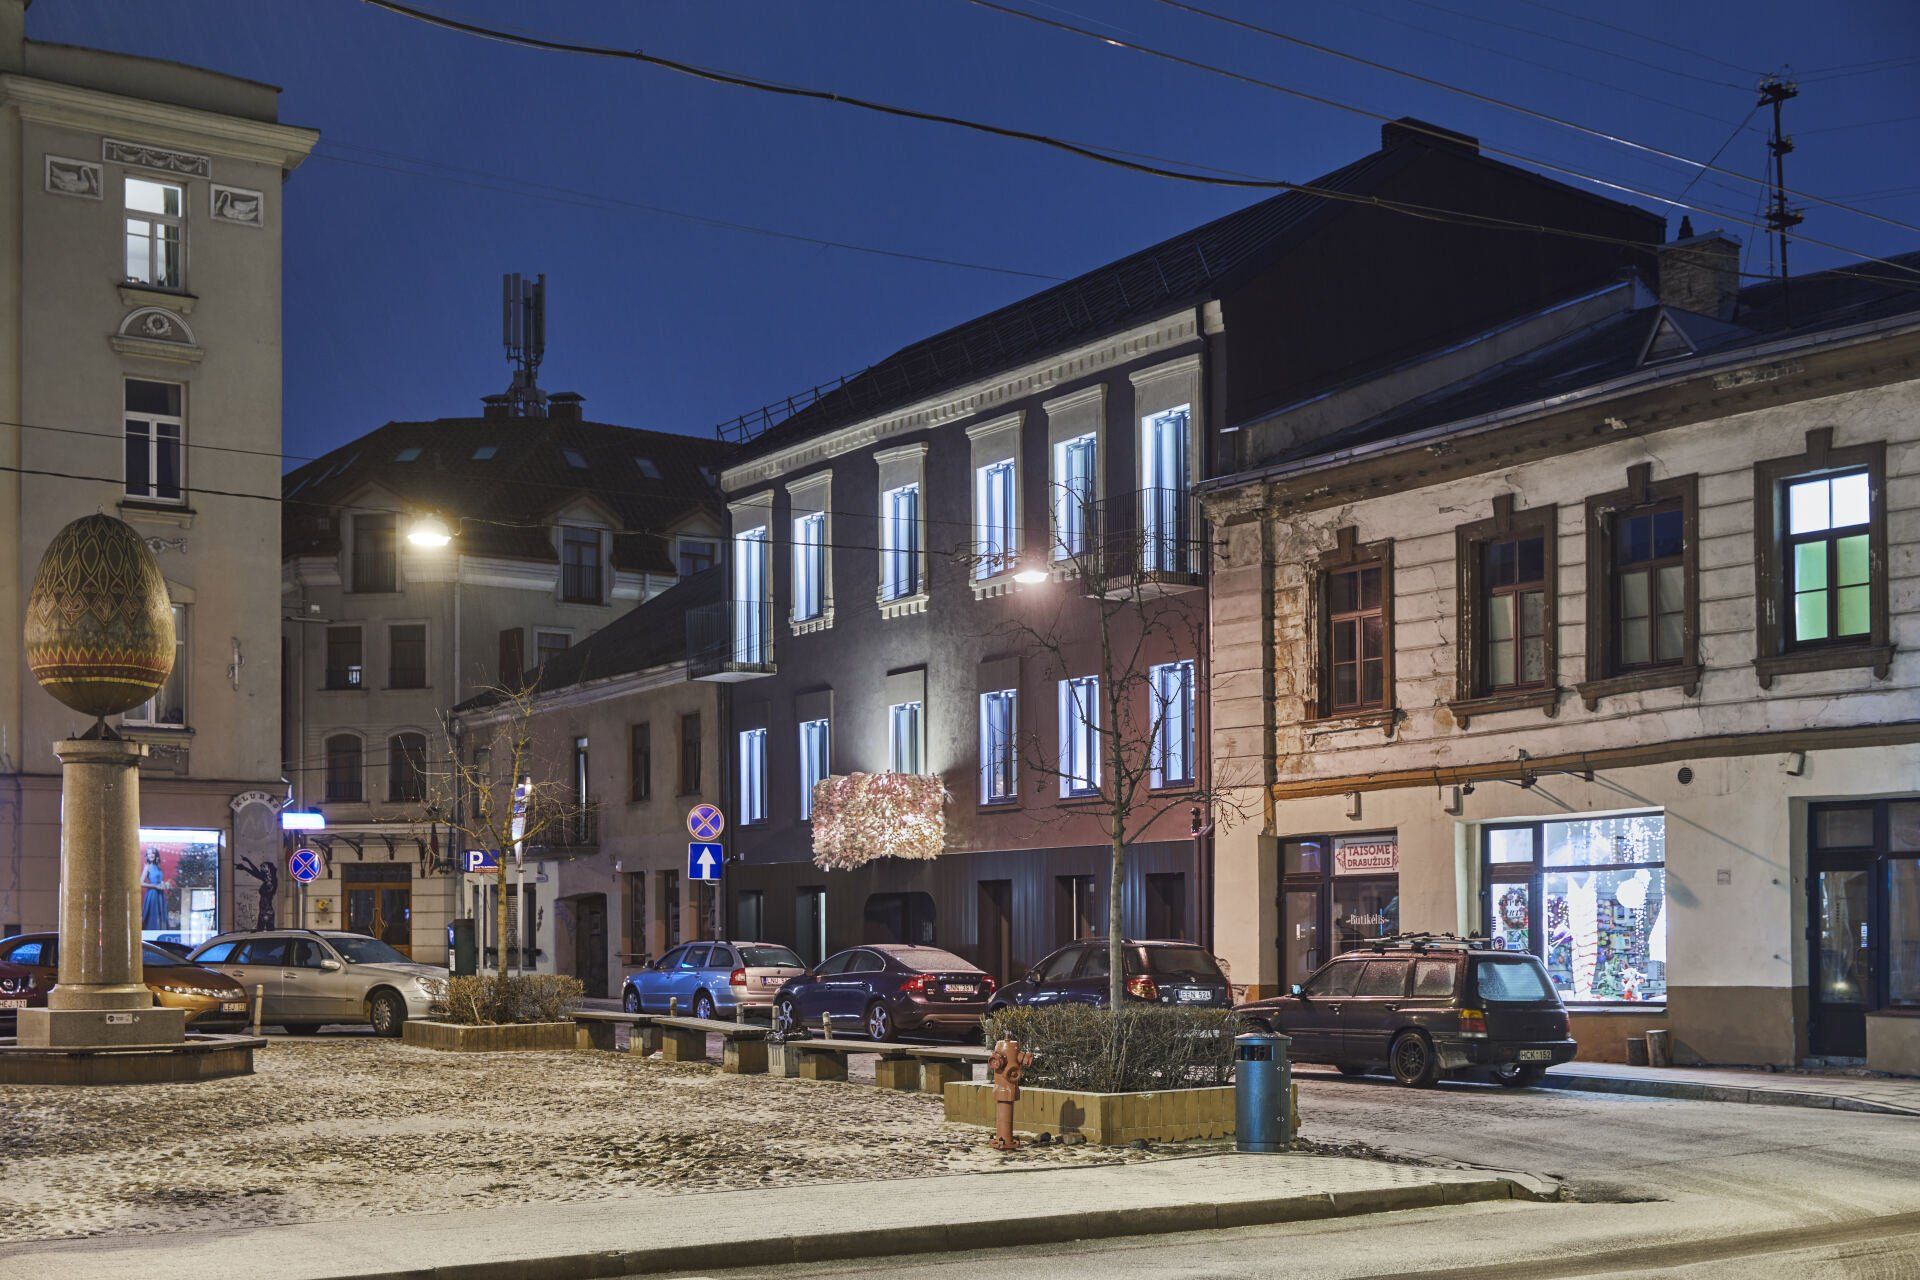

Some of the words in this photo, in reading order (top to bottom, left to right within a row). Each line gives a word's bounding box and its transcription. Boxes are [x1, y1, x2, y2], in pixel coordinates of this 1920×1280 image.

[1347, 845, 1390, 856] TAISOME
[469, 851, 484, 872] P
[1347, 856, 1391, 867] DRABUŽIUS
[1520, 1051, 1535, 1059] HCK
